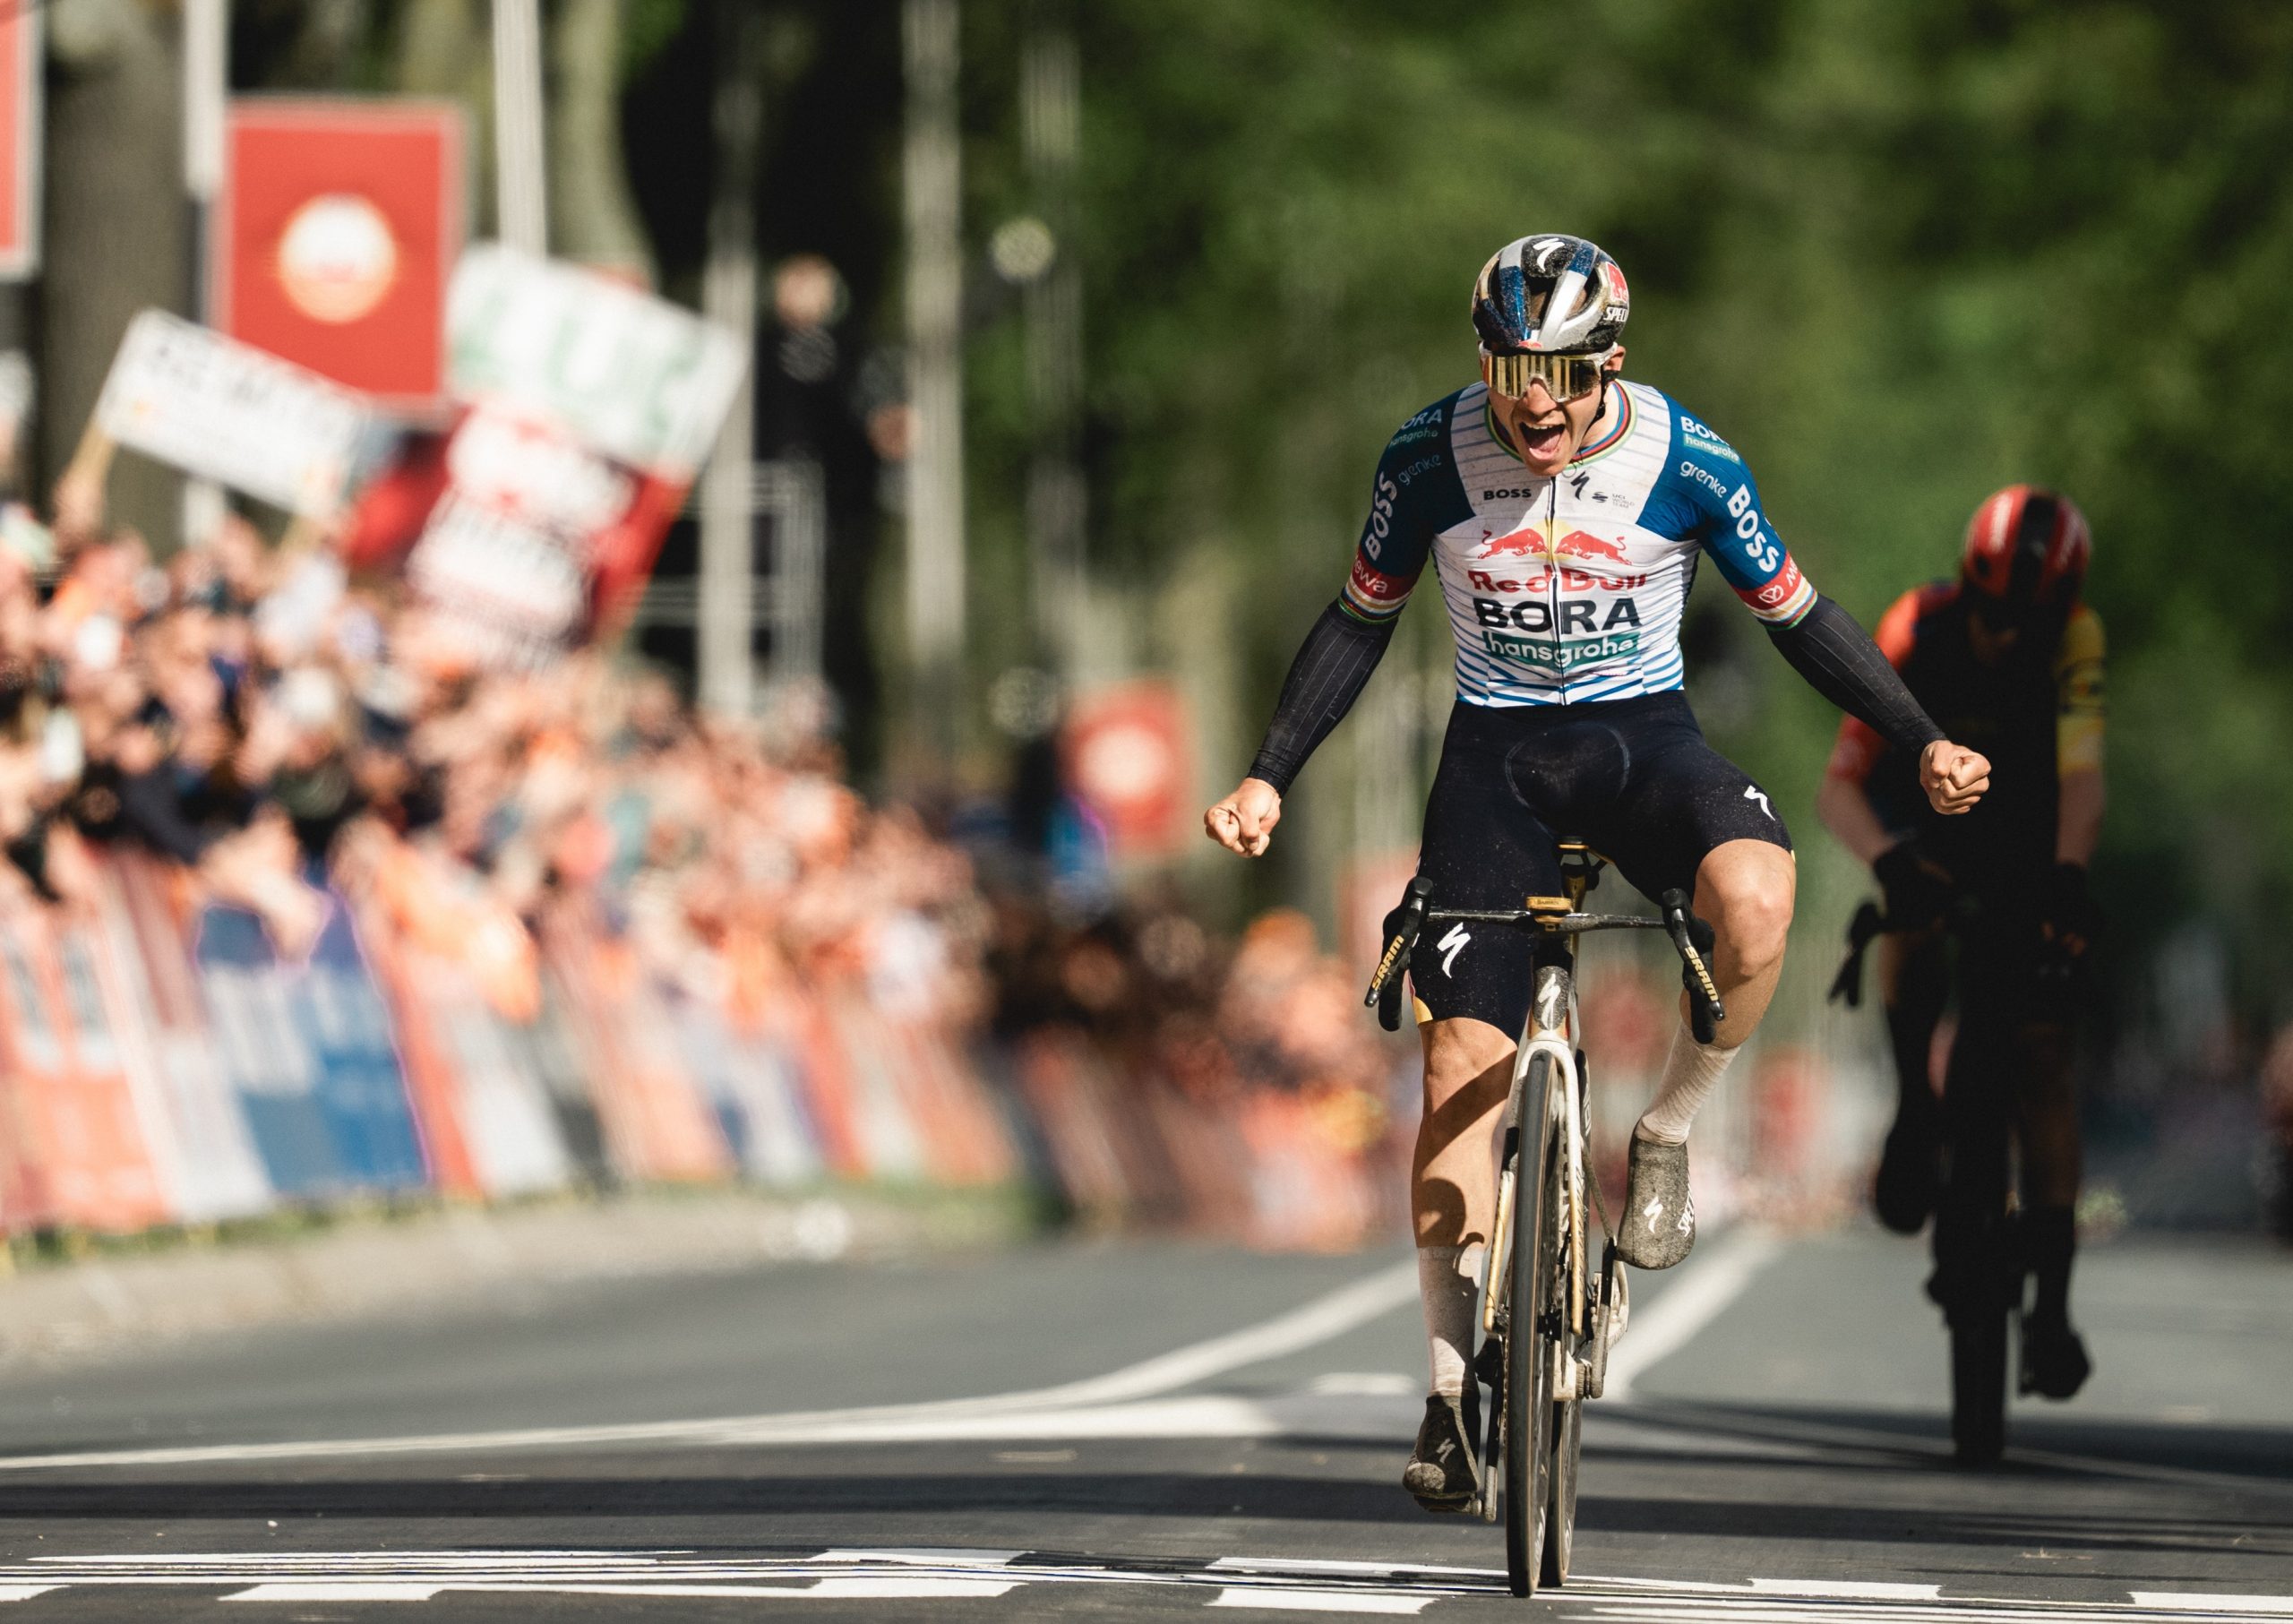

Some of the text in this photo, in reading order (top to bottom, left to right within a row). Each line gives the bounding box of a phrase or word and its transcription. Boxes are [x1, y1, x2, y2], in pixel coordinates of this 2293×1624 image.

[1400, 408, 1442, 430] ORA
[1388, 427, 1438, 449] ansgrohe
[1685, 433, 1740, 462] hansgrohe
[1398, 453, 1441, 485] grenke
[1679, 460, 1727, 498] grenke
[1483, 488, 1532, 501] BOSS
[1364, 471, 1397, 562] BOSS
[1727, 483, 1780, 572] BOSS
[1353, 557, 1387, 594] ewa
[1467, 564, 1648, 593] Red Bull
[1473, 597, 1644, 635] BORA
[1489, 632, 1635, 668] hansgrohe
[1371, 934, 1404, 992] SRAM
[1684, 946, 1719, 1001] SRAM
